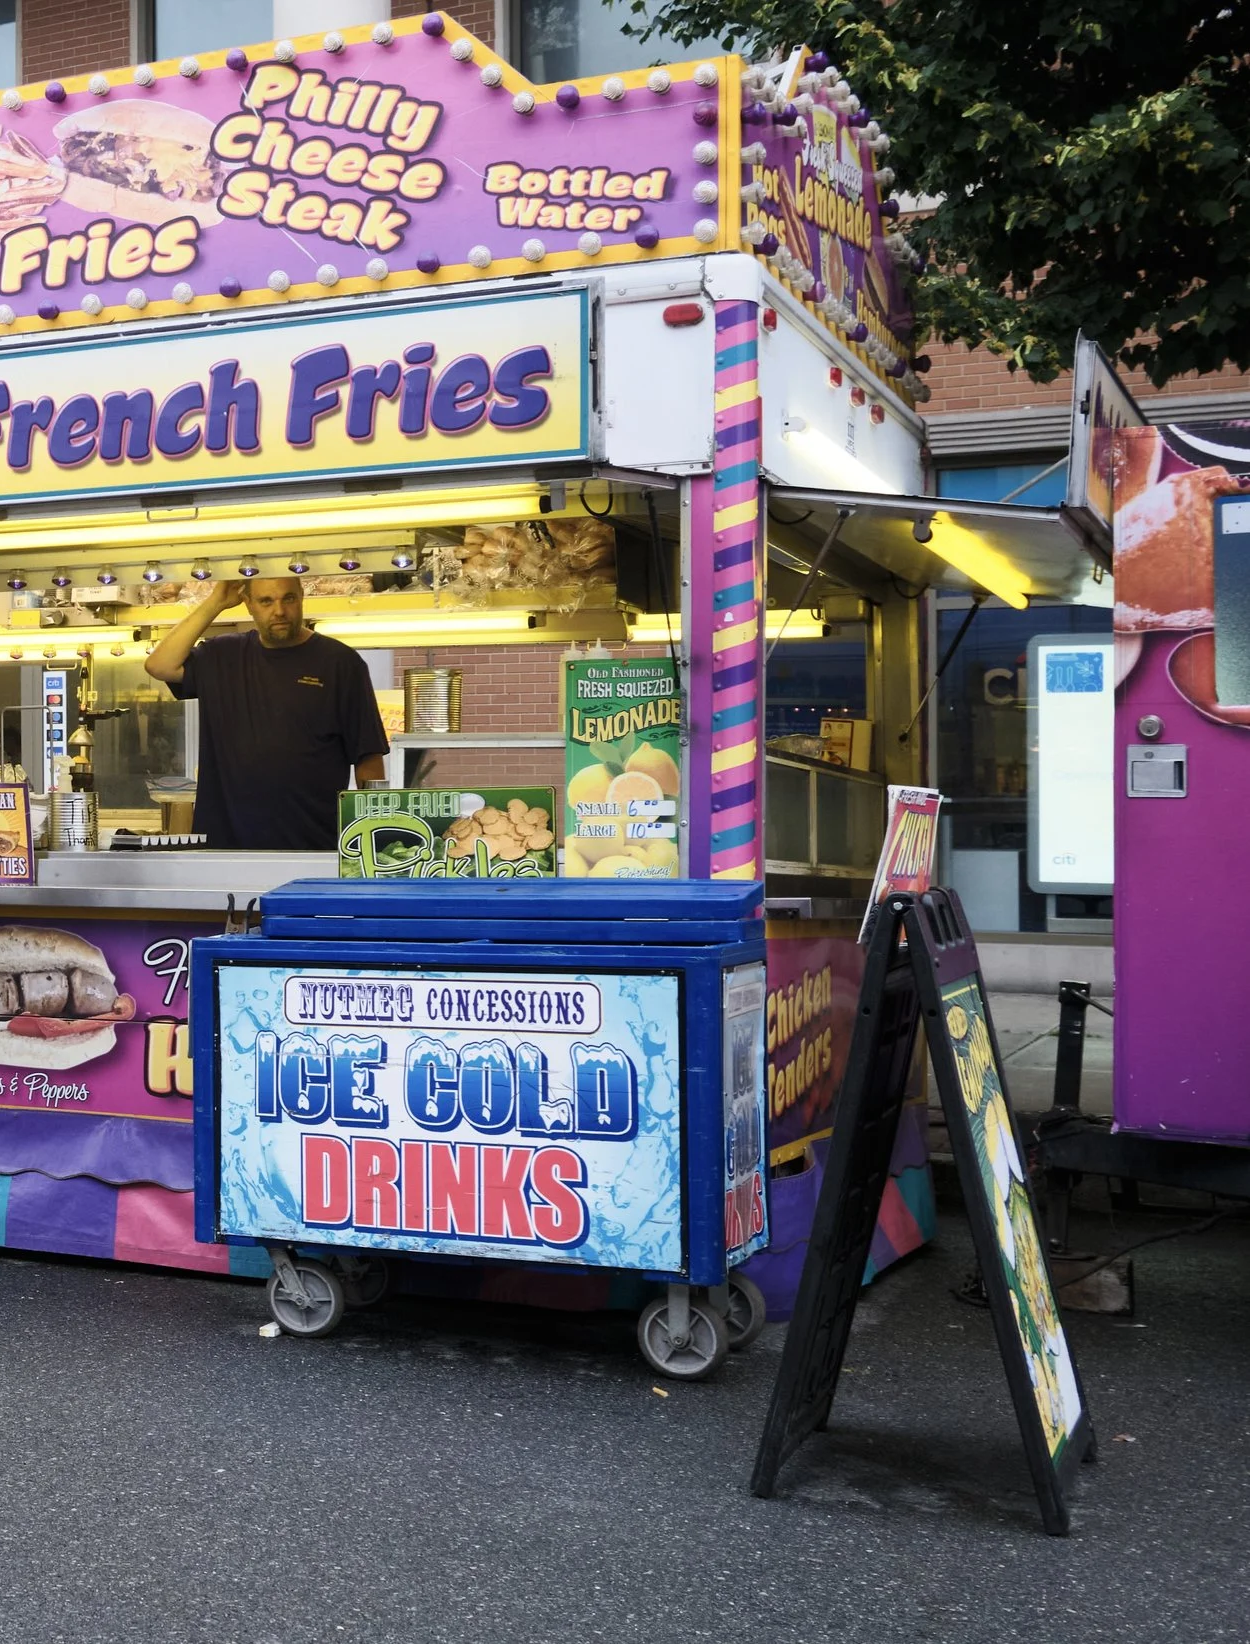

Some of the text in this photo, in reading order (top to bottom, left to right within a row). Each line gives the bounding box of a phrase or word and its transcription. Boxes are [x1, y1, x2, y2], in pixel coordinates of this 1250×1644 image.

[243, 61, 444, 155] Philly
[210, 109, 447, 202] Cheese
[483, 161, 669, 201] Bottled
[216, 165, 411, 254] Steak
[495, 196, 643, 232] Water
[795, 155, 872, 251] Lemonade
[286, 341, 552, 447] Fries
[578, 677, 674, 698] FRESH SQUEEZED
[587, 667, 664, 679] OLD FASHIONED
[571, 698, 681, 744] LEMONADE
[355, 792, 462, 818] DEEP FRIED
[577, 803, 621, 816] SMALL
[576, 825, 616, 838] LARGE
[1053, 852, 1076, 865] citi
[299, 982, 584, 1025] NUTMEG CONCESSIONS
[768, 965, 831, 1050] Chicken
[10, 1072, 19, 1096] &
[23, 1072, 90, 1108] Peppers
[255, 1031, 389, 1130] ICE
[403, 1036, 639, 1142] COLD
[300, 1133, 591, 1250] DRINKS
